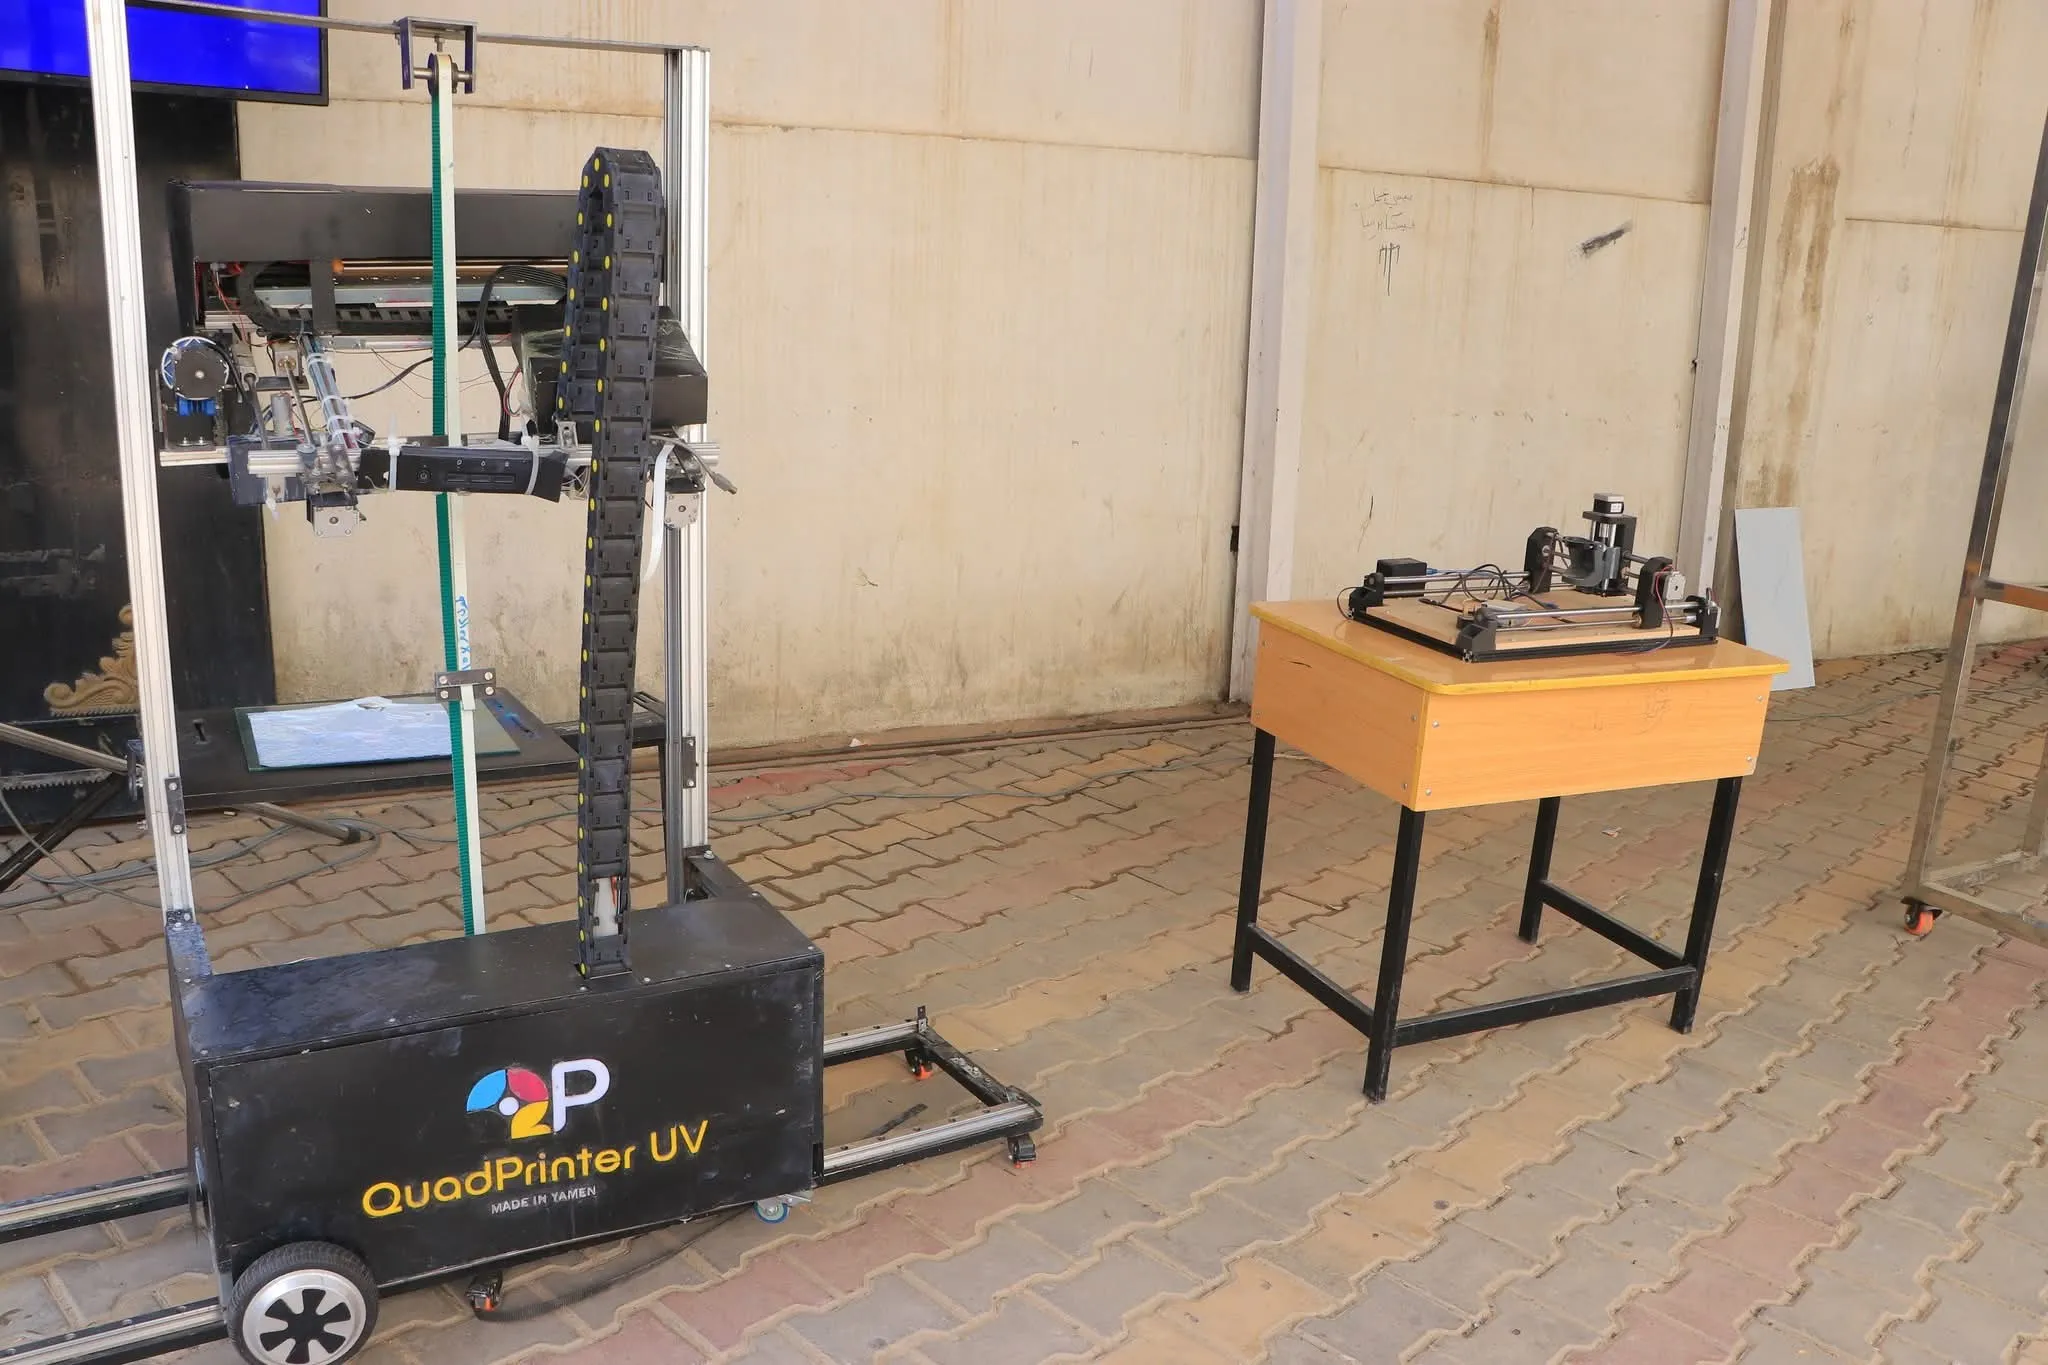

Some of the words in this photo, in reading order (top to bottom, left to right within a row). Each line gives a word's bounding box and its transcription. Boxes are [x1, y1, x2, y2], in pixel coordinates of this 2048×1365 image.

[362, 1145, 637, 1217] QuadPrinter
[650, 1119, 709, 1162] UV
[491, 1197, 529, 1215] MADE
[533, 1194, 547, 1206] IN
[551, 1185, 597, 1203] YAMEN
